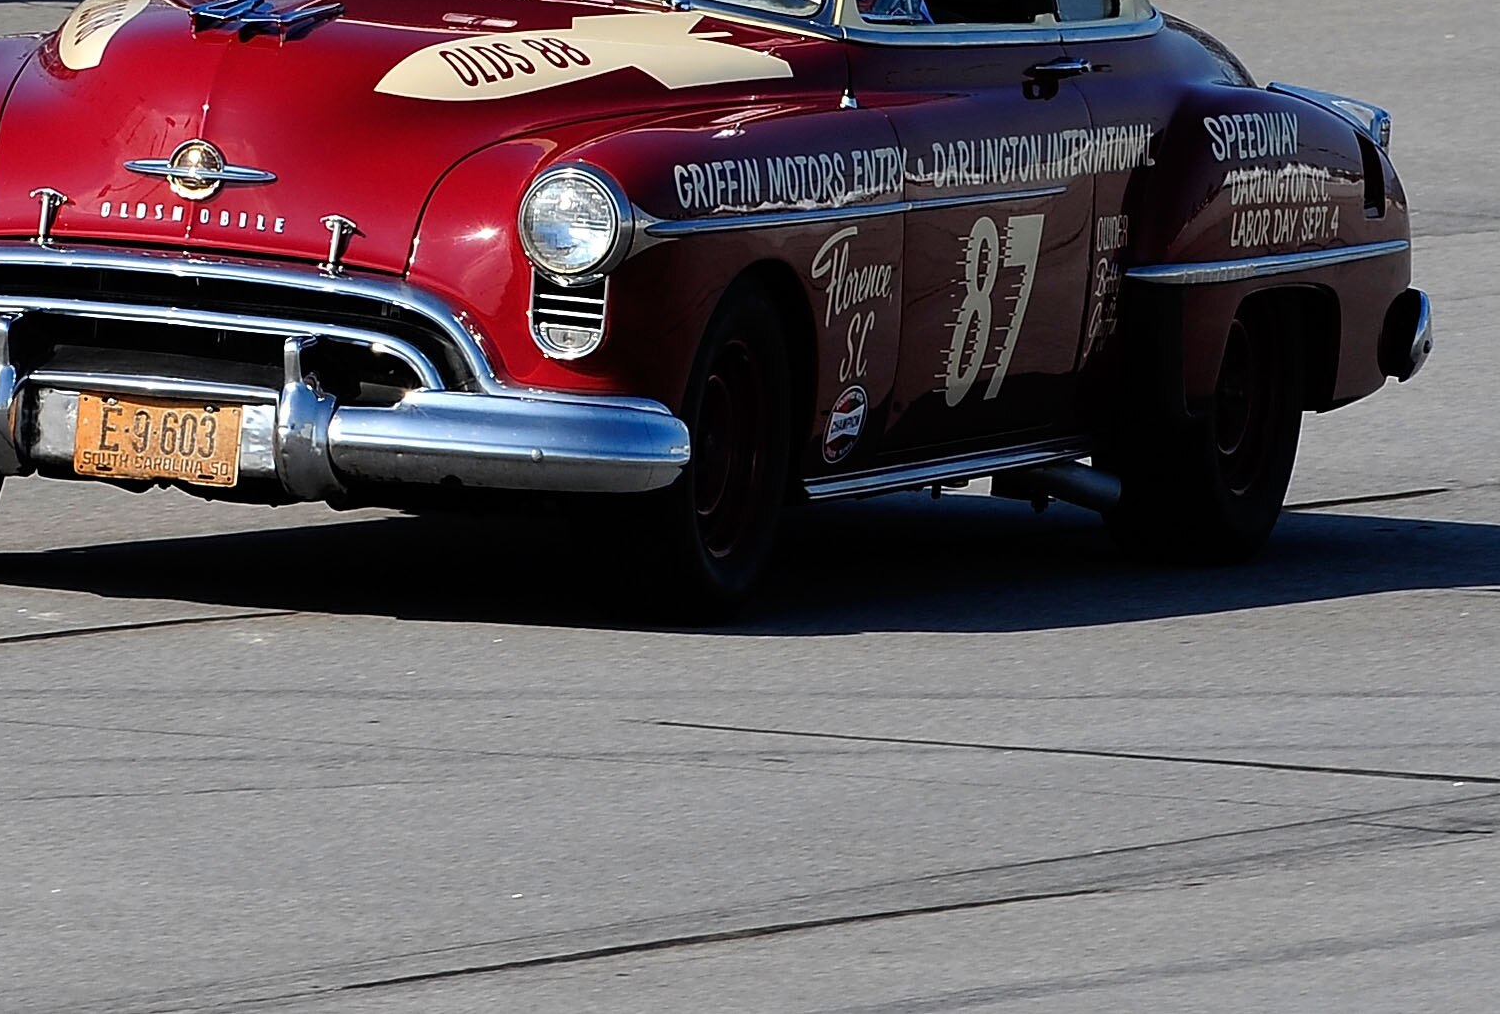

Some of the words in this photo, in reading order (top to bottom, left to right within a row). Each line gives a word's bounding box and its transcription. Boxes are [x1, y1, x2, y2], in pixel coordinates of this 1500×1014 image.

[438, 42, 536, 87] OLDS
[520, 37, 591, 69] 88
[1203, 112, 1299, 162] SPEEDWAY
[673, 157, 760, 209] GRIFFIN
[766, 151, 846, 201] MOTORS
[851, 146, 908, 193] ENTRY
[932, 134, 1042, 188] DARLINGTON
[1047, 123, 1156, 180] INTERNATIONAL
[100, 201, 286, 234] OLDSMOBILE
[1096, 214, 1129, 252] OWNER
[1230, 209, 1270, 247] LABOR
[1301, 206, 1330, 242] SEPT.
[1330, 205, 1340, 237] 4
[811, 226, 893, 327] Florence,
[938, 214, 1045, 407] 87
[840, 310, 875, 383] S.C.
[82, 451, 129, 468] SOUTH
[134, 455, 203, 475] CAROLINA
[211, 461, 229, 476] 50
